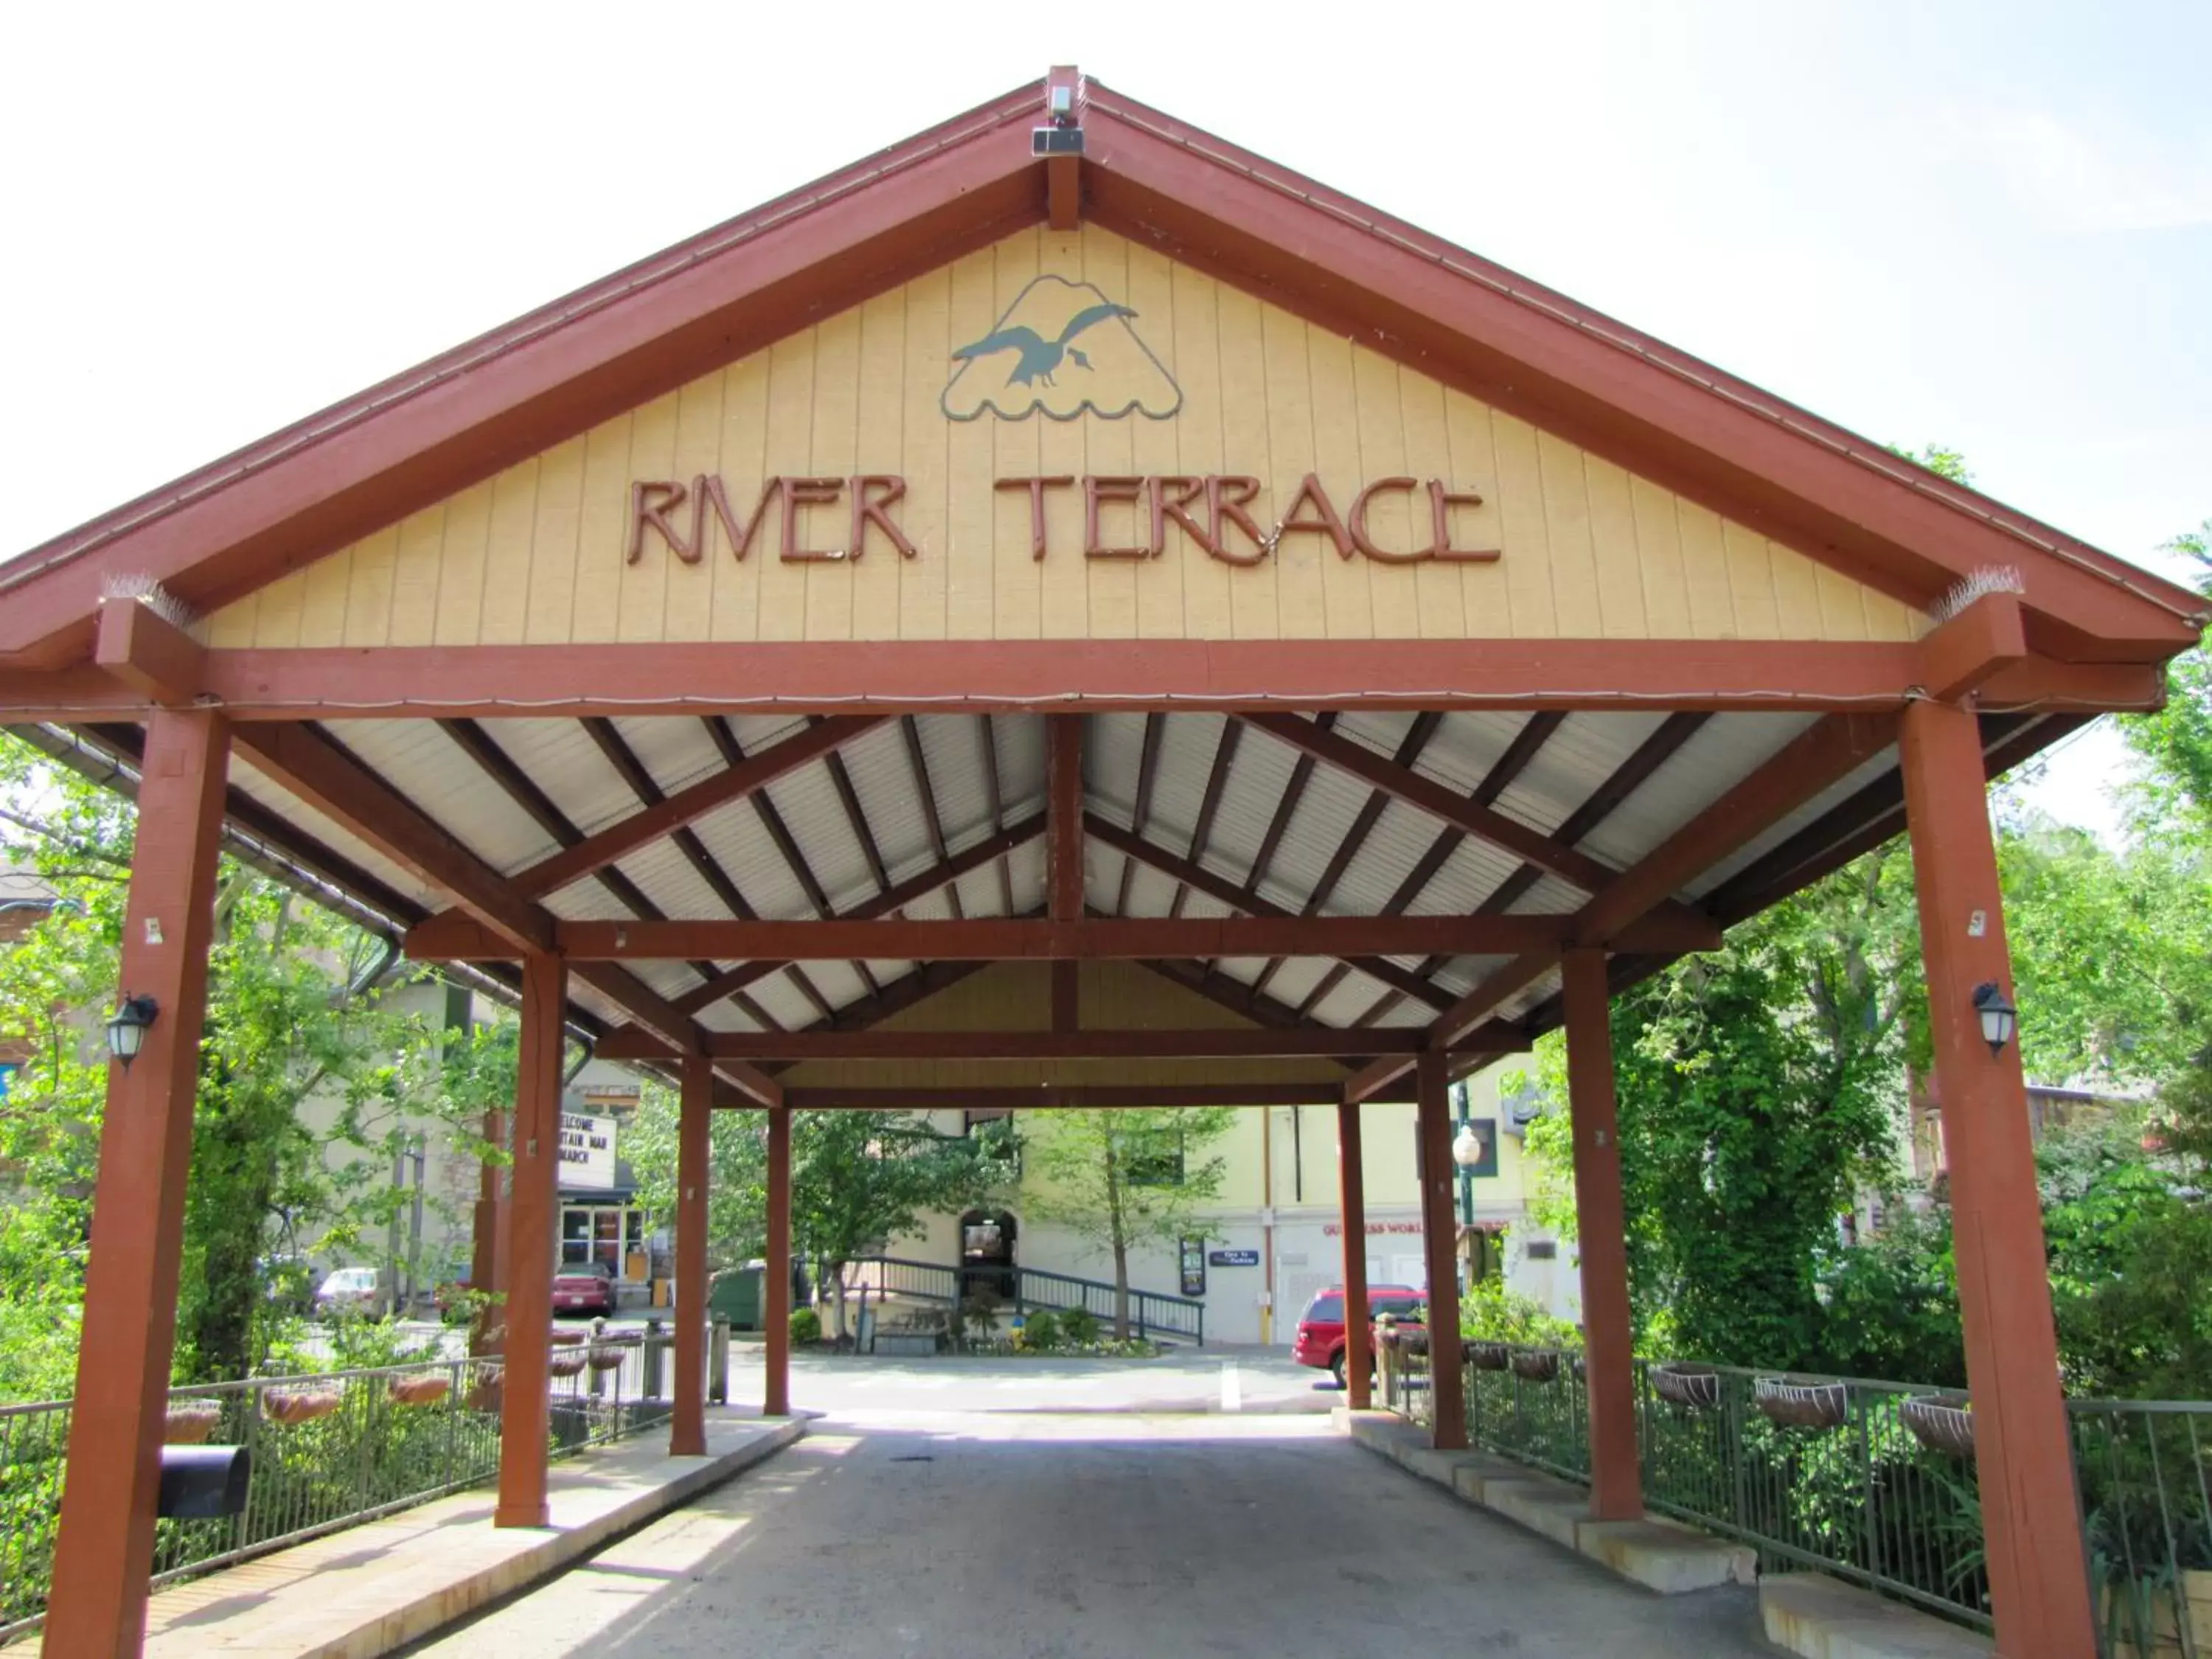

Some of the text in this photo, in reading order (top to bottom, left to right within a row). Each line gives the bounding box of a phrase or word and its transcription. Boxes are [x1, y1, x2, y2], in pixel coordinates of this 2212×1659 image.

[627, 472, 1502, 566] RIVER TERRACE
[560, 1115, 594, 1132] ELCOME
